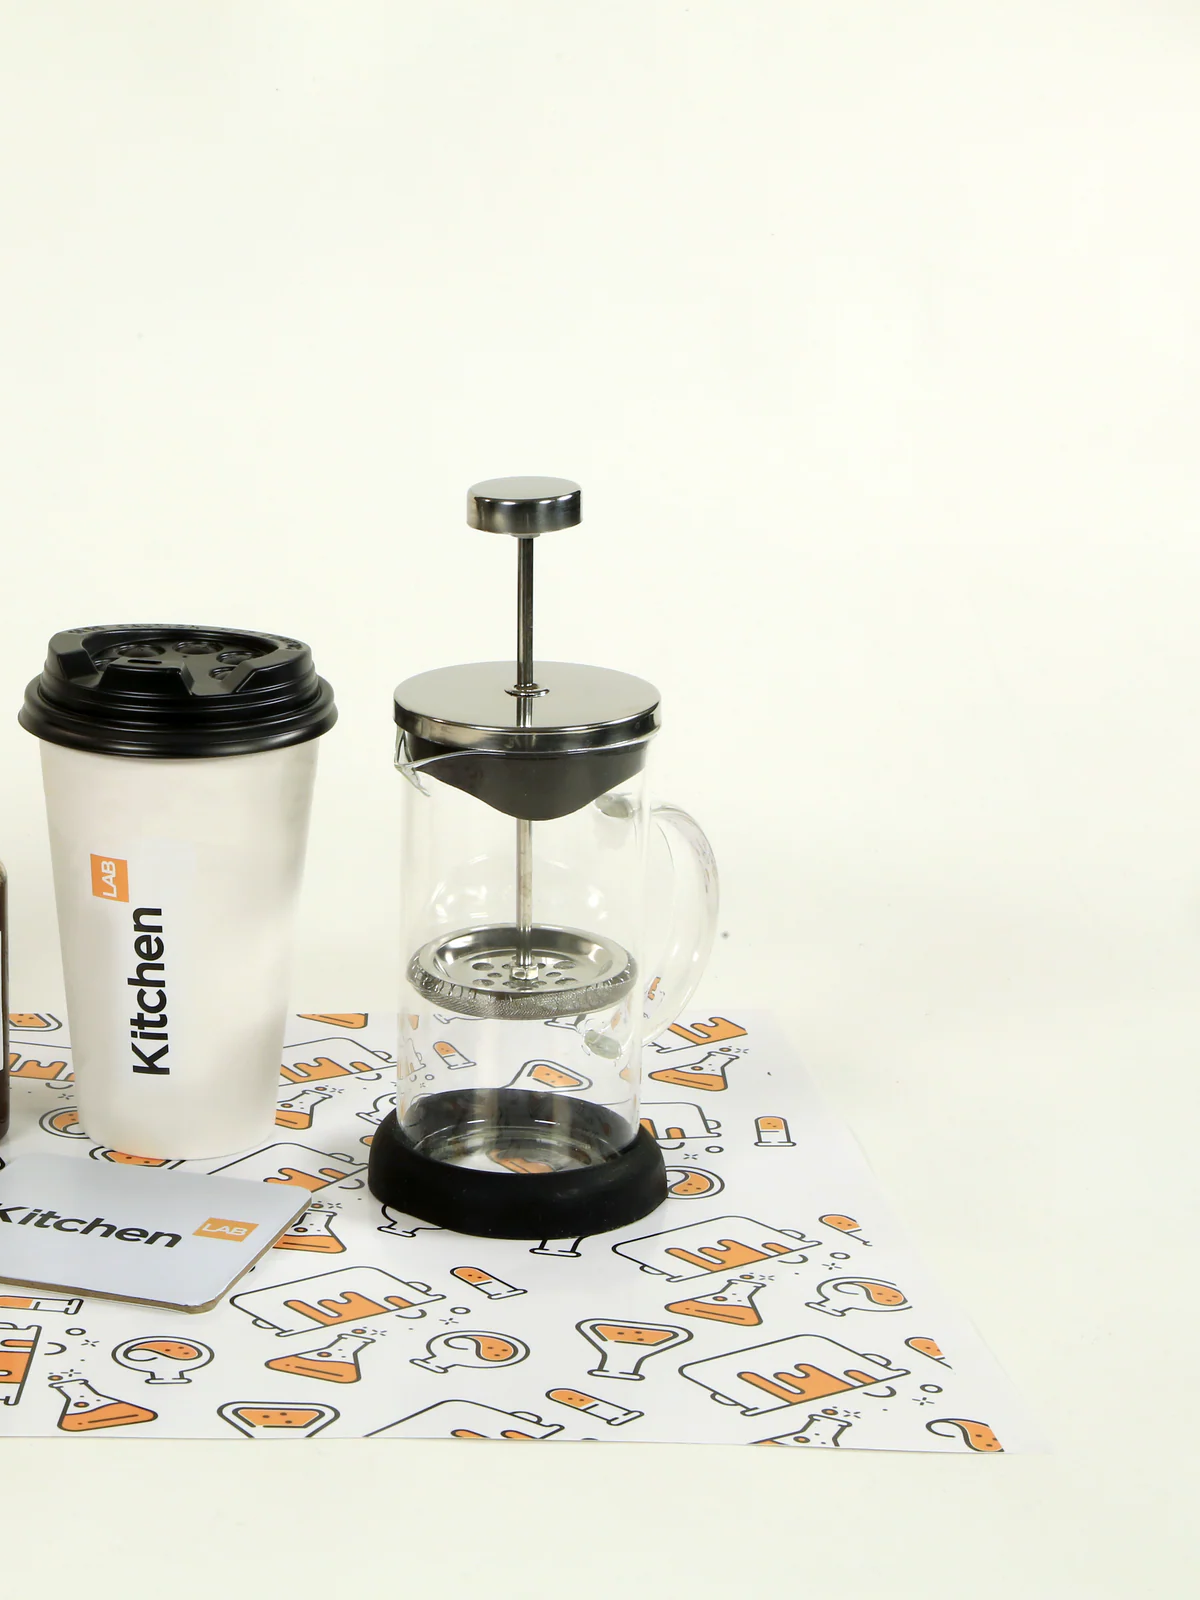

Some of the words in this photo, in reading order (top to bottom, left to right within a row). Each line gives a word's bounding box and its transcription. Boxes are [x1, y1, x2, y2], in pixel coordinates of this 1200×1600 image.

[101, 860, 117, 898] LAB
[127, 907, 170, 1075] Kitchen
[202, 1222, 248, 1237] LAB
